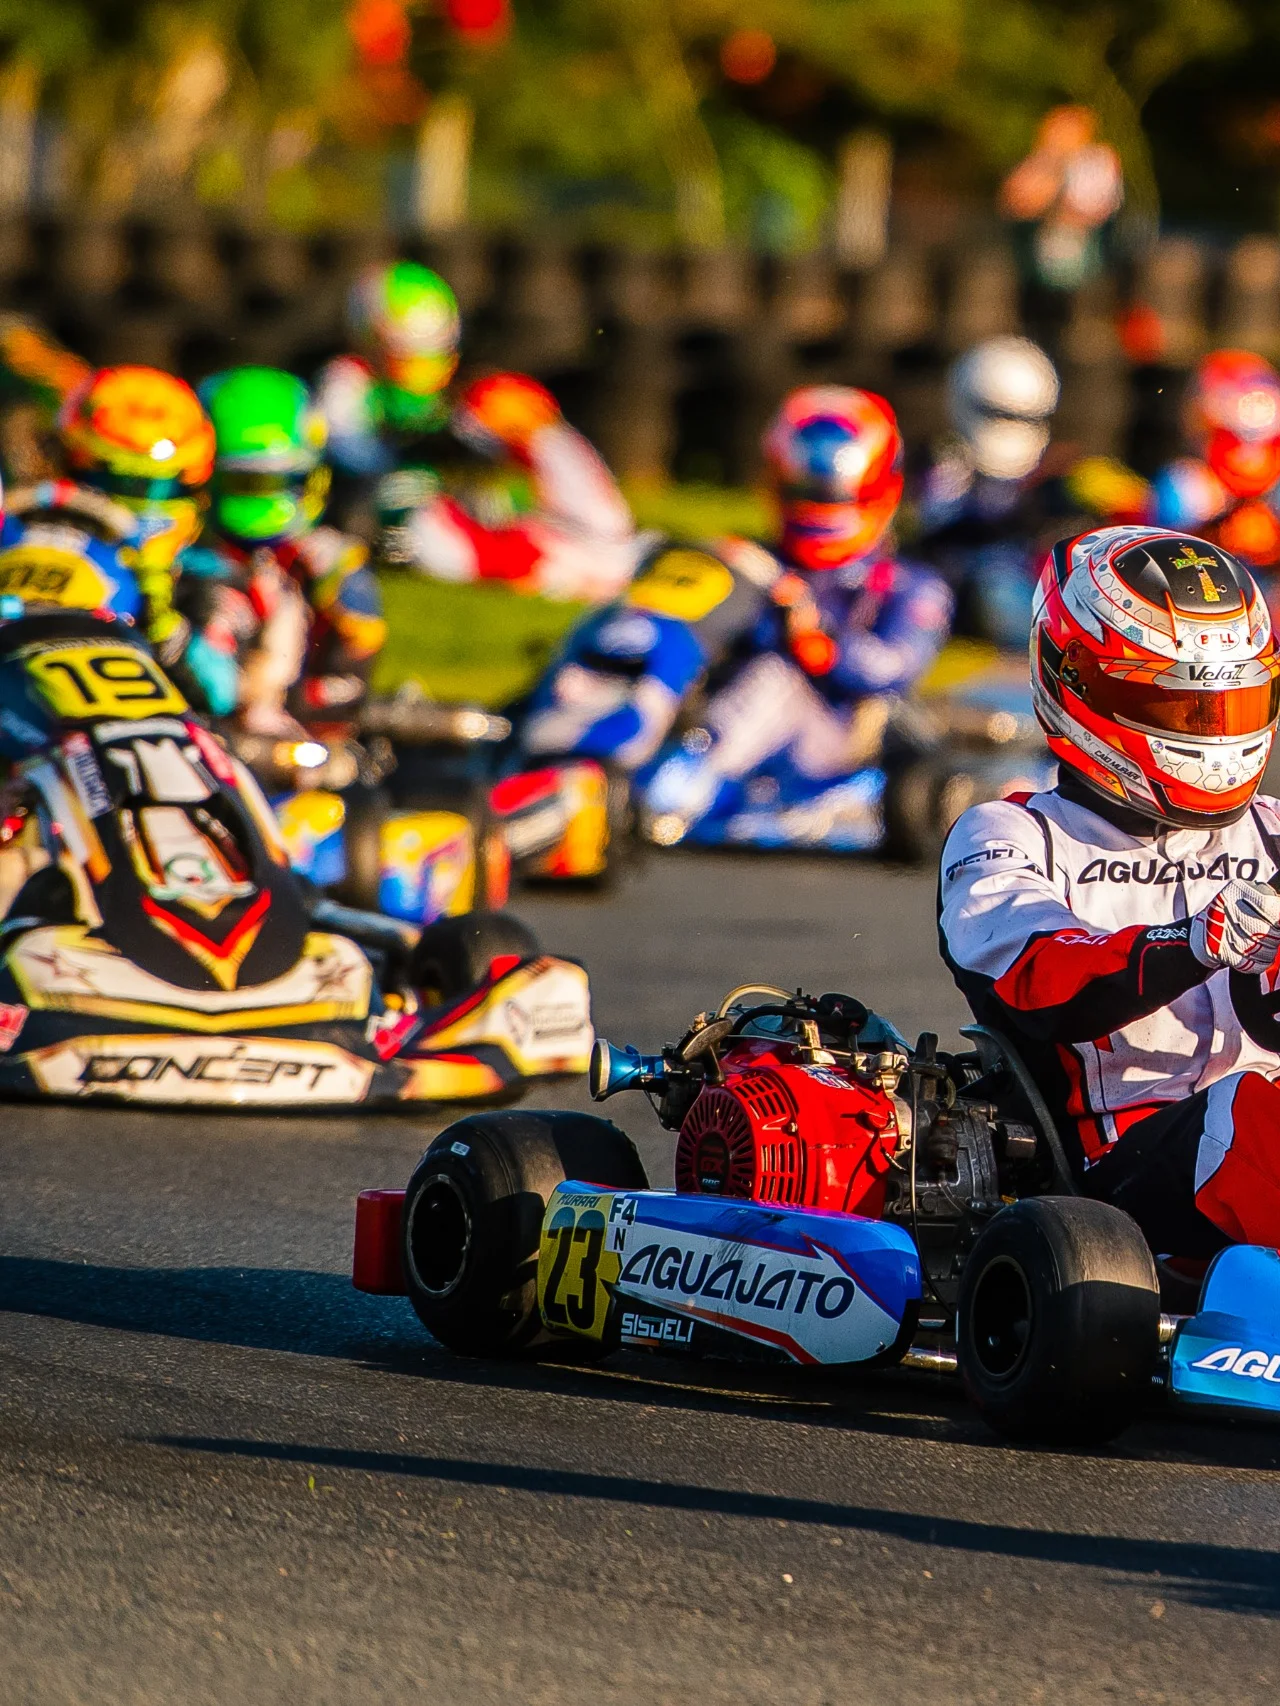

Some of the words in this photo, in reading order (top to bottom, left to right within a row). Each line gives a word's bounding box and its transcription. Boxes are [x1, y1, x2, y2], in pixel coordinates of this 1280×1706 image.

[44, 656, 168, 704] 19
[1094, 750, 1112, 763] CAIO
[1111, 761, 1142, 781] MURARI
[78, 1045, 335, 1092] CONCEPT
[557, 1194, 601, 1208] MURARI
[609, 1198, 637, 1226] F4
[613, 1227, 627, 1251] N
[543, 1206, 606, 1330] 23
[620, 1244, 855, 1319] AGUAJATO
